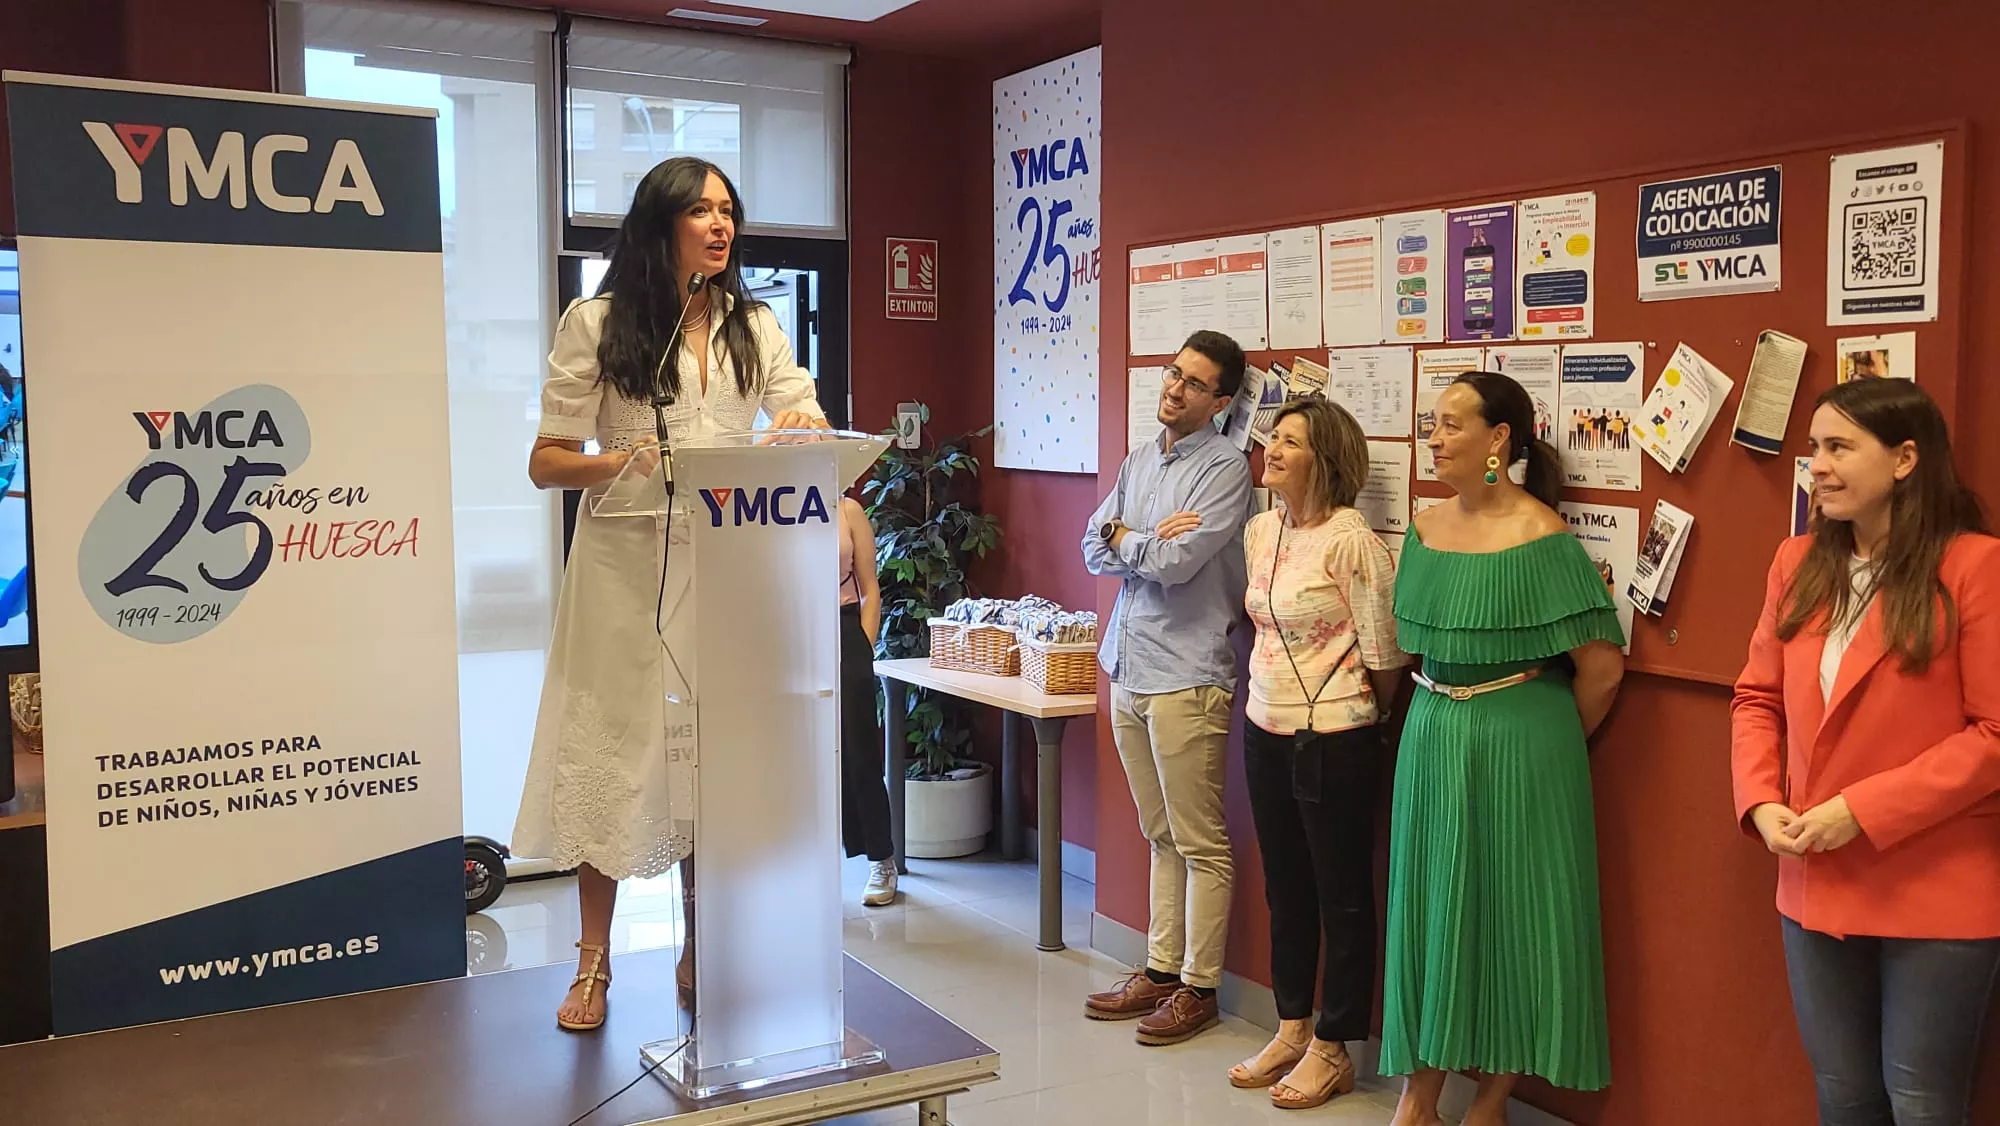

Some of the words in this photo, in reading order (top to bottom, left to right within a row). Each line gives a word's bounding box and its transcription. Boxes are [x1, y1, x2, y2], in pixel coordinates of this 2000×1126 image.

[82, 121, 385, 216] YMCA
[1010, 136, 1089, 189] YMCA
[1650, 181, 1735, 213] AGENCIA
[1738, 177, 1766, 202] DE
[1067, 215, 1093, 240] años
[1645, 200, 1771, 237] COLOCACIÓN
[1008, 196, 1073, 313] 25
[1683, 234, 1741, 250] 9900000145
[1696, 253, 1767, 281] YMCA
[890, 299, 934, 313] EXTINTOR
[1020, 318, 1040, 335] 1999
[1049, 316, 1072, 333] 2024
[133, 410, 284, 450] YMCA
[244, 483, 322, 514] años
[327, 483, 370, 507] en
[698, 485, 829, 528] YMCA
[104, 455, 286, 598] 25
[278, 517, 419, 562] HUESCA
[1582, 512, 1617, 528] YMCA
[116, 605, 160, 628] 1999
[175, 602, 222, 625] 2024
[95, 740, 254, 773] TRABAJAMOS
[261, 734, 321, 757] PARA
[97, 766, 265, 800] DESARROLLAR
[272, 763, 297, 781] EL
[303, 749, 421, 778] POTENCIAL
[98, 808, 129, 828] DE
[136, 796, 220, 823] NIÑOS,
[227, 787, 298, 813] NIÑAS
[304, 785, 317, 803] Y
[324, 775, 419, 802] JÓVENES
[159, 933, 380, 986] www.ymca.es
